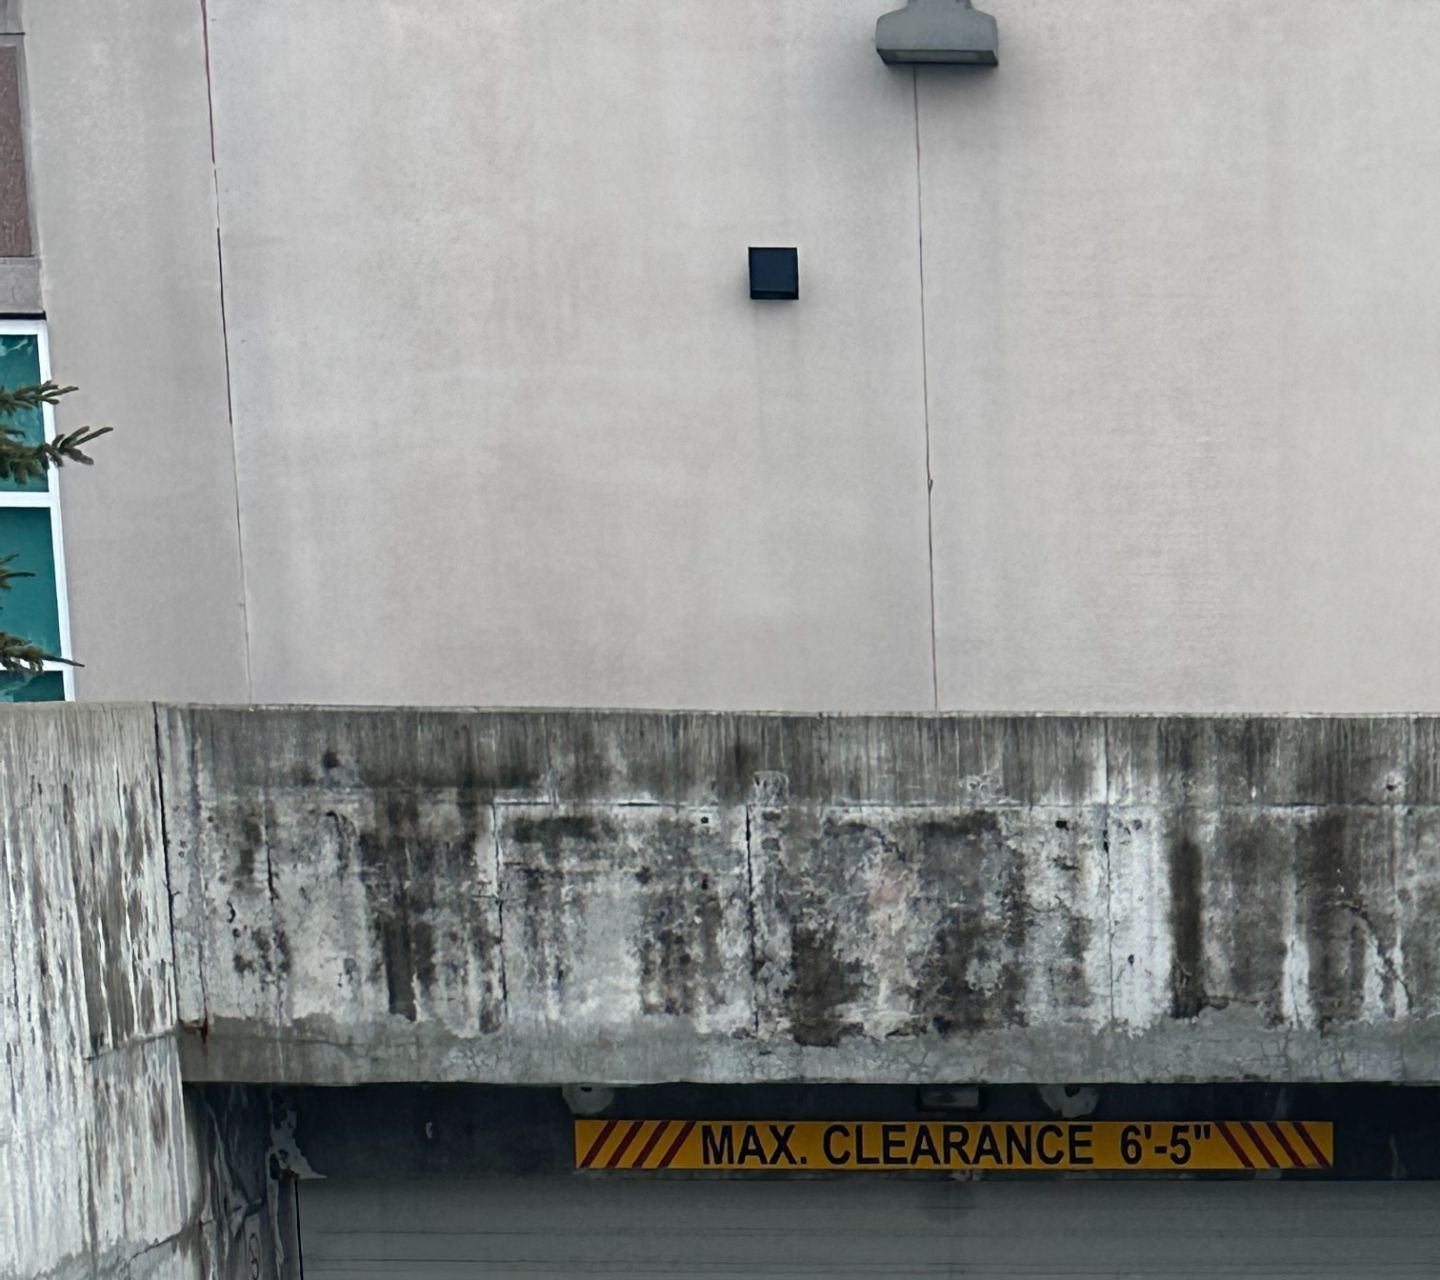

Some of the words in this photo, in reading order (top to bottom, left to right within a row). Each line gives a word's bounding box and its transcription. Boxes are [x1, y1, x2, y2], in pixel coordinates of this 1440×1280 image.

[702, 1125, 807, 1164] MAX.
[823, 1124, 1094, 1165] CLEARANCE
[1121, 1124, 1211, 1165] 6'-5"
